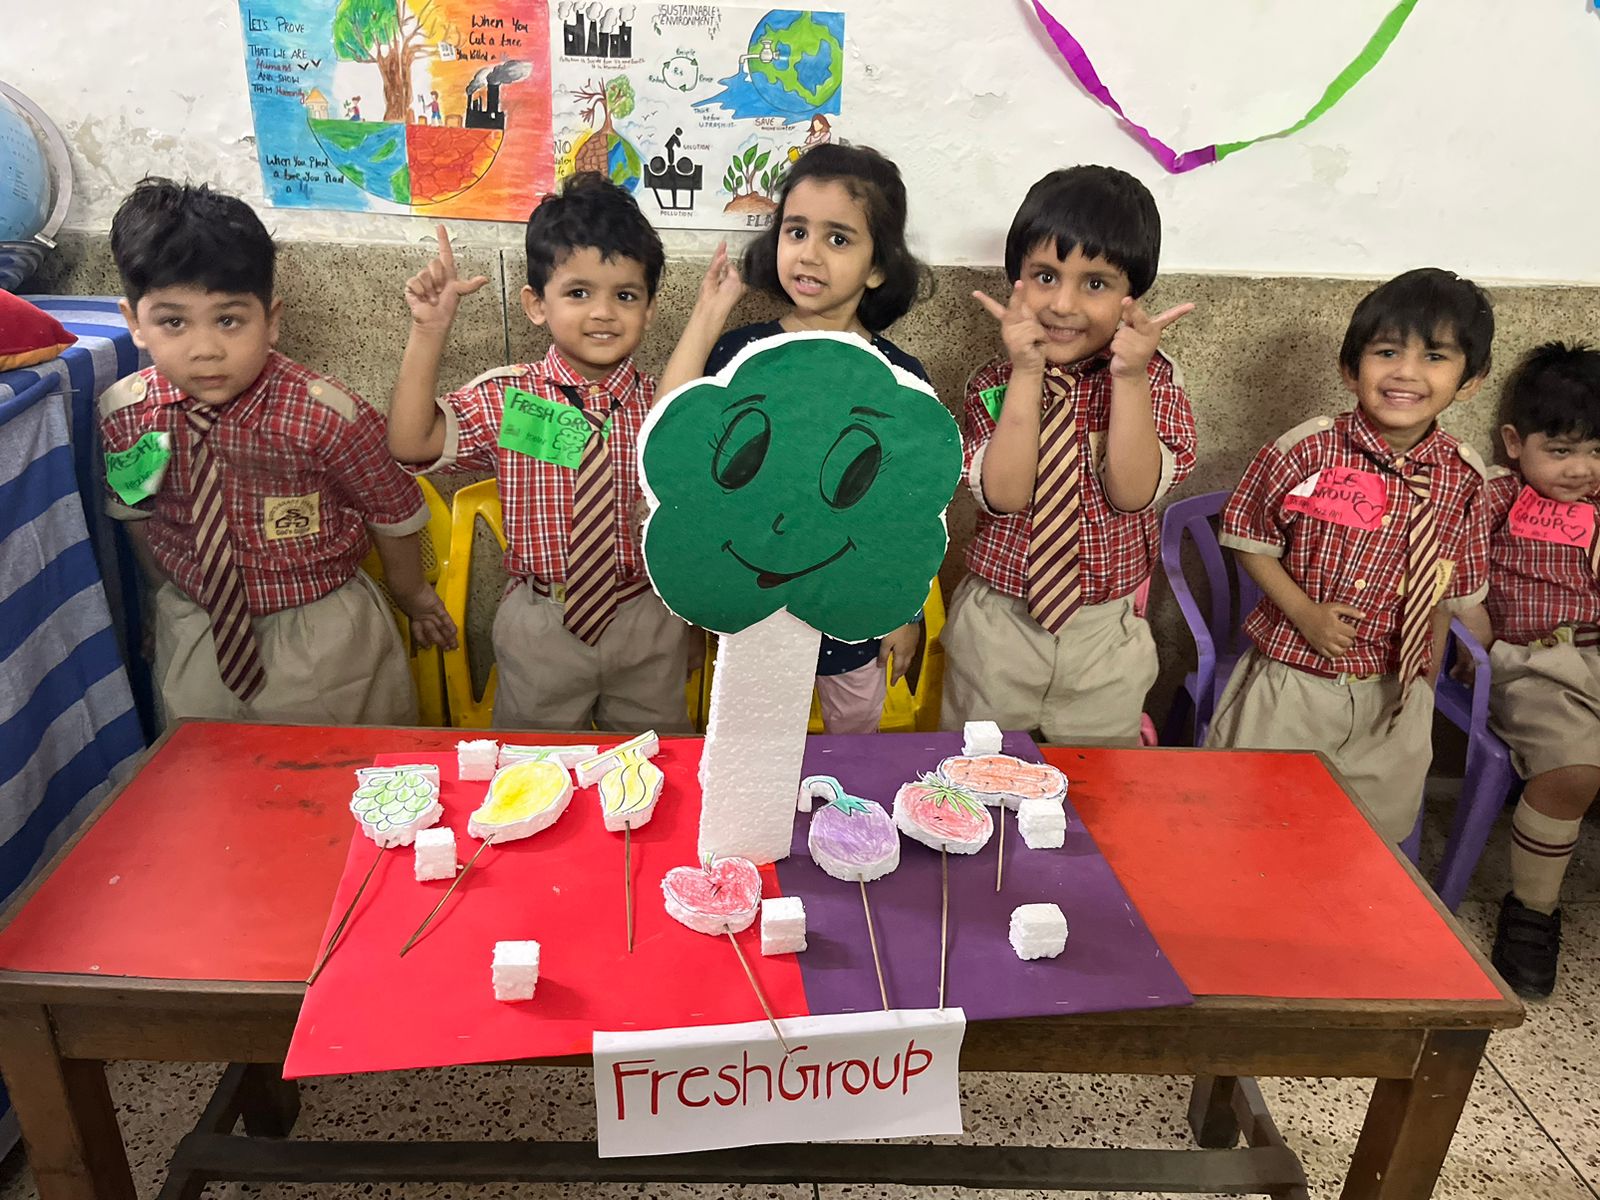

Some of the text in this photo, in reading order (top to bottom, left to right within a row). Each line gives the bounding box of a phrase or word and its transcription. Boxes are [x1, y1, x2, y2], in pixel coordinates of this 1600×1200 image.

[659, 4, 716, 17] SUSTAINABLE
[275, 16, 305, 33] PROVE
[472, 14, 529, 33] When You
[660, 15, 714, 26] ENVIRONMENT
[469, 31, 487, 45] Cut
[489, 38, 495, 46] a
[248, 44, 307, 59] THAT WE ARE
[755, 118, 775, 127] SAVE
[554, 139, 572, 154] NO
[266, 154, 290, 166] When
[746, 214, 774, 227] PLA
[510, 392, 554, 423] FRESH
[1514, 508, 1563, 530] GROUP
